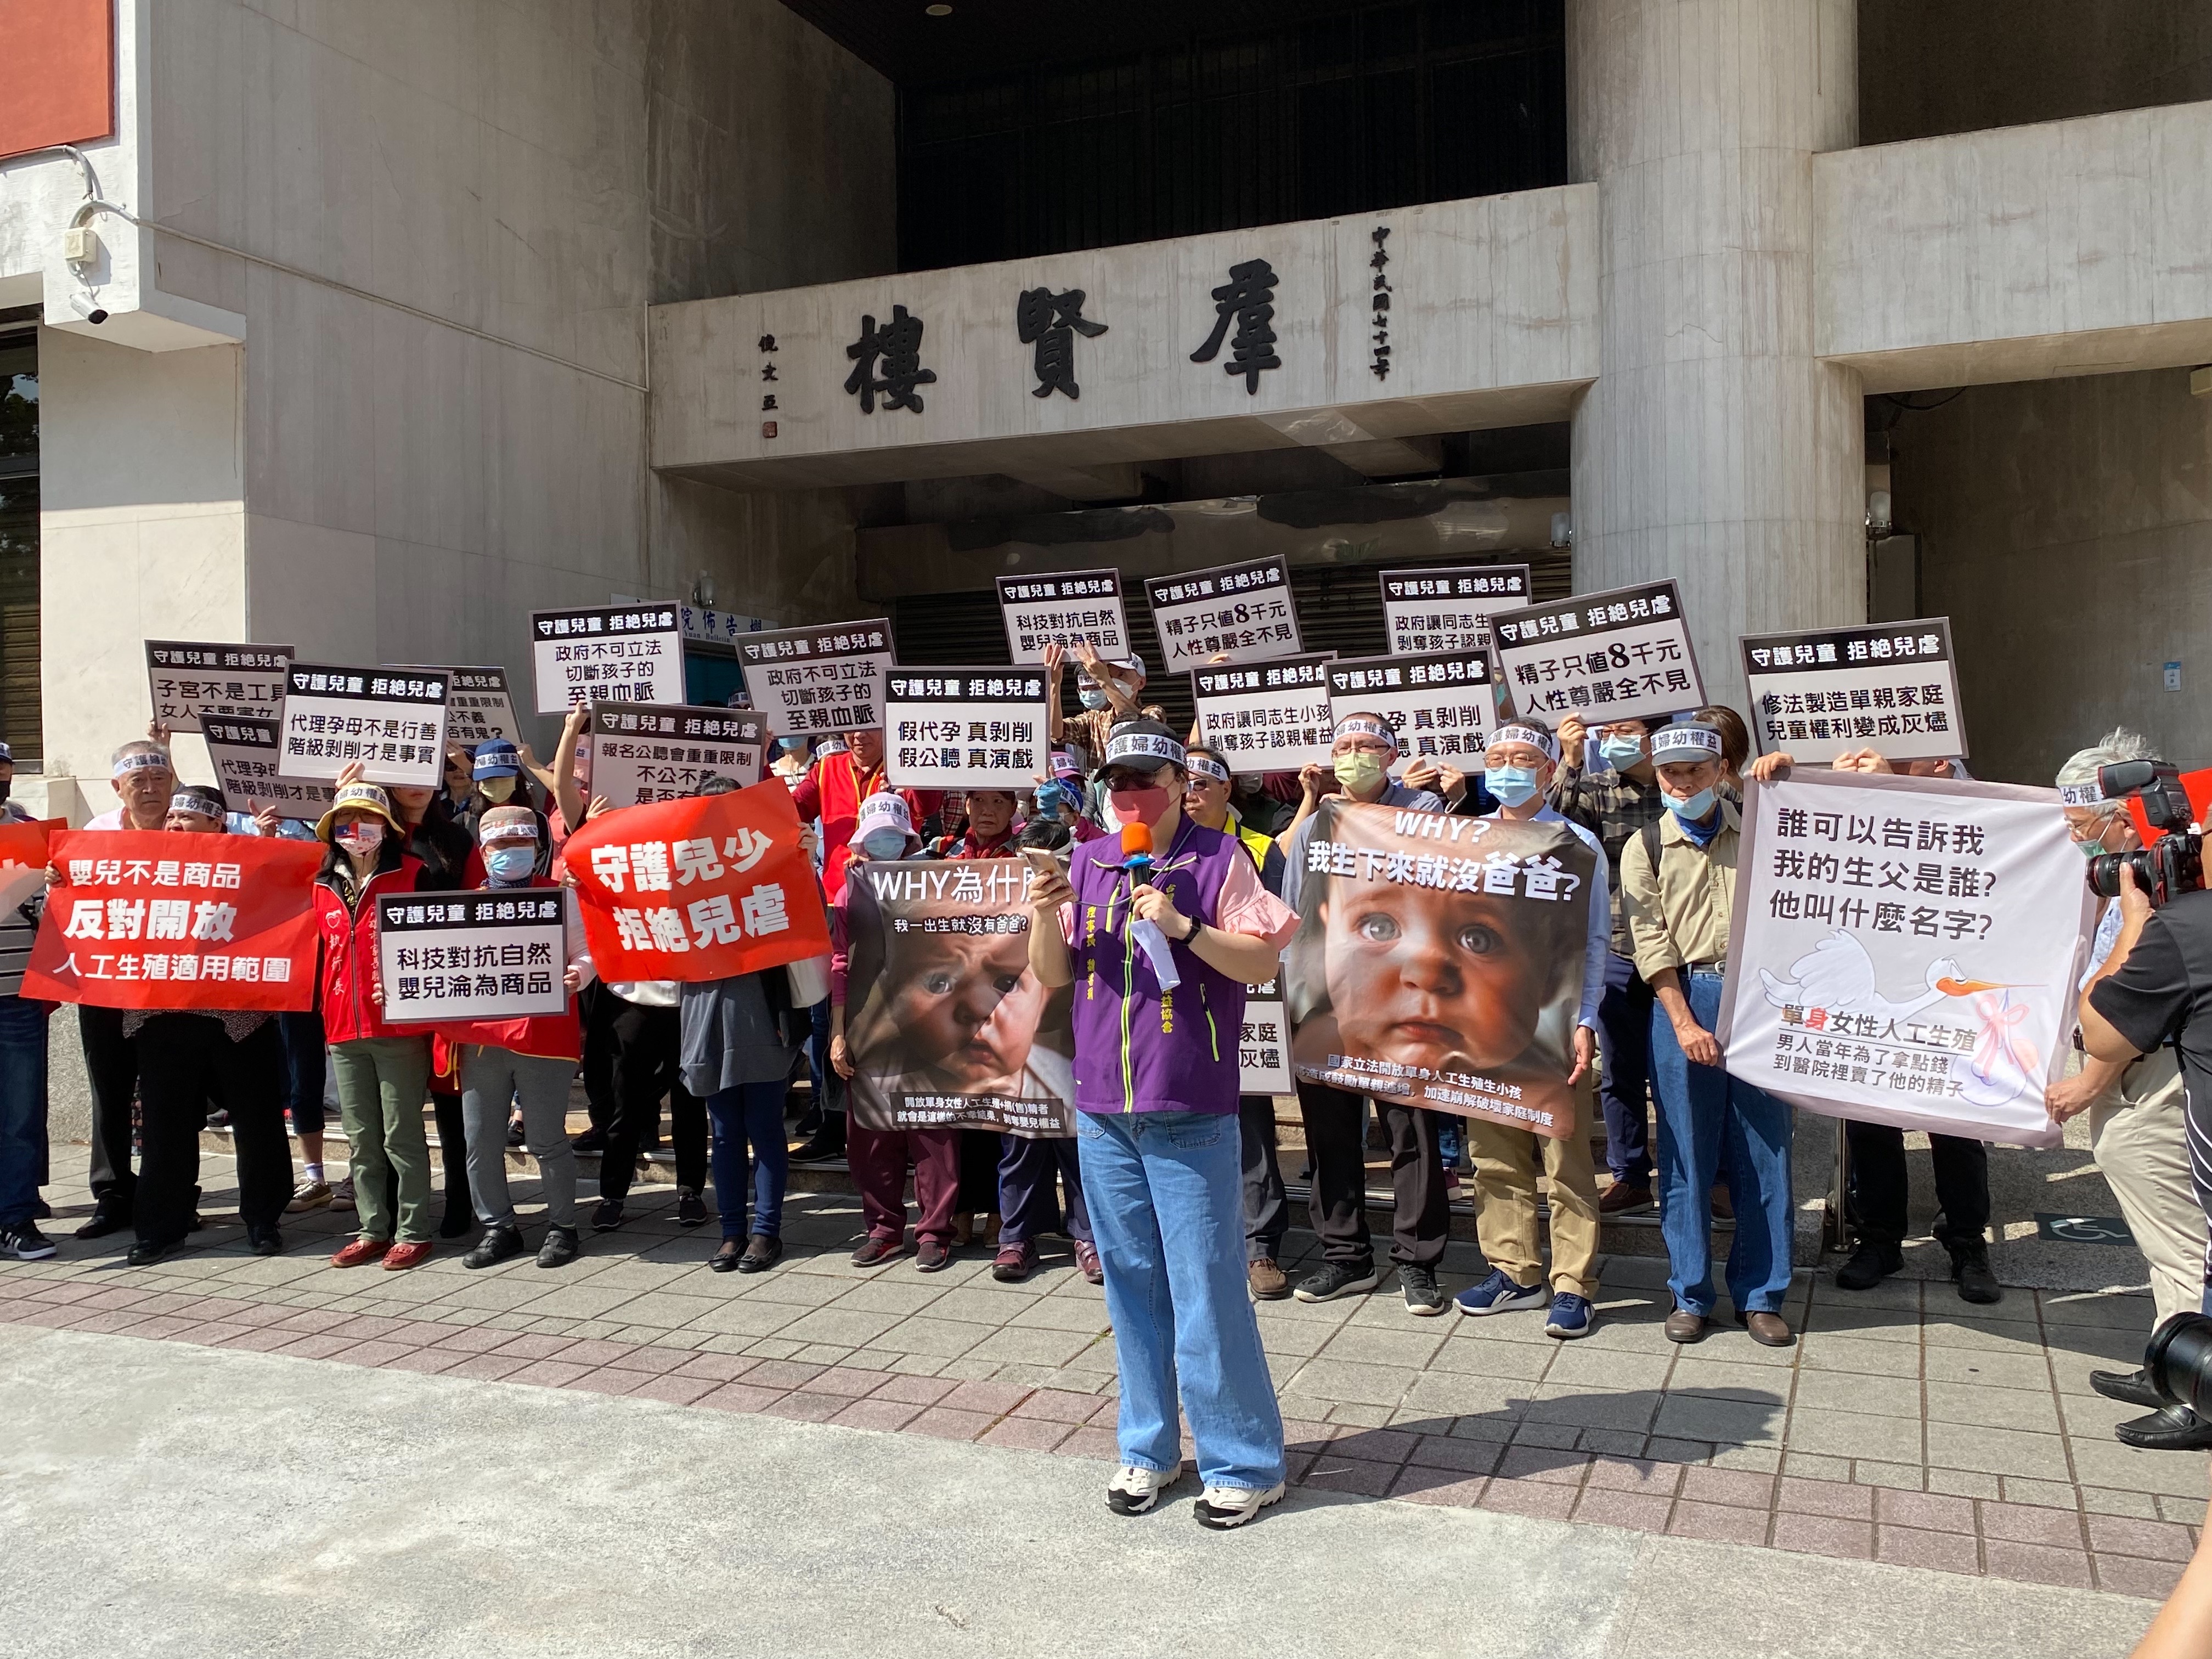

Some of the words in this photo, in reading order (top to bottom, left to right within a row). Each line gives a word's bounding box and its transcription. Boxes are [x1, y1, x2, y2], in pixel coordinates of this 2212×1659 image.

[1005, 584, 1056, 599] 守護兒童
[1061, 579, 1113, 595] 拒絕兒虐
[1155, 580, 1214, 601] 守護兒童
[1220, 567, 1280, 591] 拒絕兒虐
[1389, 580, 1451, 596] 守護兒童
[1458, 577, 1522, 594] 拒絕兒虐
[538, 617, 602, 635] 守護兒童
[609, 612, 673, 630] 拒絕兒虐
[1016, 610, 1116, 630] 科技對抗自然
[1165, 600, 1286, 636] 精子只值8千元
[1500, 612, 1580, 641] 守護兒童
[1587, 595, 1671, 627] 拒絕兒虐
[555, 640, 662, 662] 政府不可立法
[744, 640, 810, 659] 守護兒童
[817, 632, 883, 653] 拒絕兒虐
[1172, 623, 1293, 658] 人性尊嚴全不見
[1751, 643, 1838, 667] 守護兒童
[1847, 634, 1940, 661] 拒絕兒虐
[154, 650, 217, 665] 守護兒童
[1515, 638, 1681, 685] 精子只值8千元
[566, 661, 653, 682] 切斷孩子的
[767, 661, 877, 686] 政府不可立法
[1199, 671, 1260, 691] 守護兒童
[1333, 668, 1402, 690] 守護兒童
[1409, 661, 1485, 684] 拒絕兒虐
[293, 673, 363, 693] 守護兒童
[371, 678, 443, 698] 拒絕兒虐
[781, 683, 871, 706] 切斷孩子的
[891, 679, 960, 696] 守護兒童
[969, 679, 1041, 696] 拒絕兒虐
[1526, 668, 1691, 714] 人性尊嚴全不見
[1761, 684, 1944, 715] 修法製造單親家庭
[290, 714, 437, 741] 代理孕母不是行善
[602, 713, 676, 733] 守護兒童
[685, 719, 758, 738] 拒絕兒虐
[787, 704, 876, 730] 至親血脈
[1766, 710, 1949, 741] 兒童權利變成灰燼
[209, 725, 272, 742] 守護兒童
[898, 721, 960, 741] 假代孕
[1417, 732, 1486, 757] 真演戲
[602, 742, 752, 766] 報名公聽會重重限制
[898, 748, 960, 768] 假公聽
[968, 748, 1033, 769] 真演戲
[1394, 811, 1491, 843] WHY?
[1776, 808, 1985, 856] 誰可以告訴我
[591, 827, 774, 893] 守護兒少
[1307, 840, 1581, 901] 我生下來就沒爸爸?
[1774, 849, 1996, 898] 我的生父是誰?
[68, 859, 240, 889] 嬰兒不是商品
[63, 898, 237, 943] 反對開放
[387, 904, 465, 924] 守護兒童
[476, 901, 556, 921] 拒絕兒虐
[612, 883, 789, 952] 拒絕兒虐
[894, 916, 1027, 934] 我一出生就沒有爸爸?
[1769, 889, 1993, 940] 他叫什麼名字?
[53, 952, 291, 983] 人工生殖適用範圍
[397, 943, 552, 970] 科技對抗自然
[398, 972, 552, 1000] 嬰兒淪為商品
[1239, 1022, 1278, 1042] 家庭
[1781, 1003, 1977, 1053] 單身女性人工生殖
[1239, 1048, 1280, 1069] 灰燼
[1776, 1033, 1949, 1075] 男人當年為了拿點錢
[1773, 1053, 1964, 1097] 到醫院裡賣了他的精子
